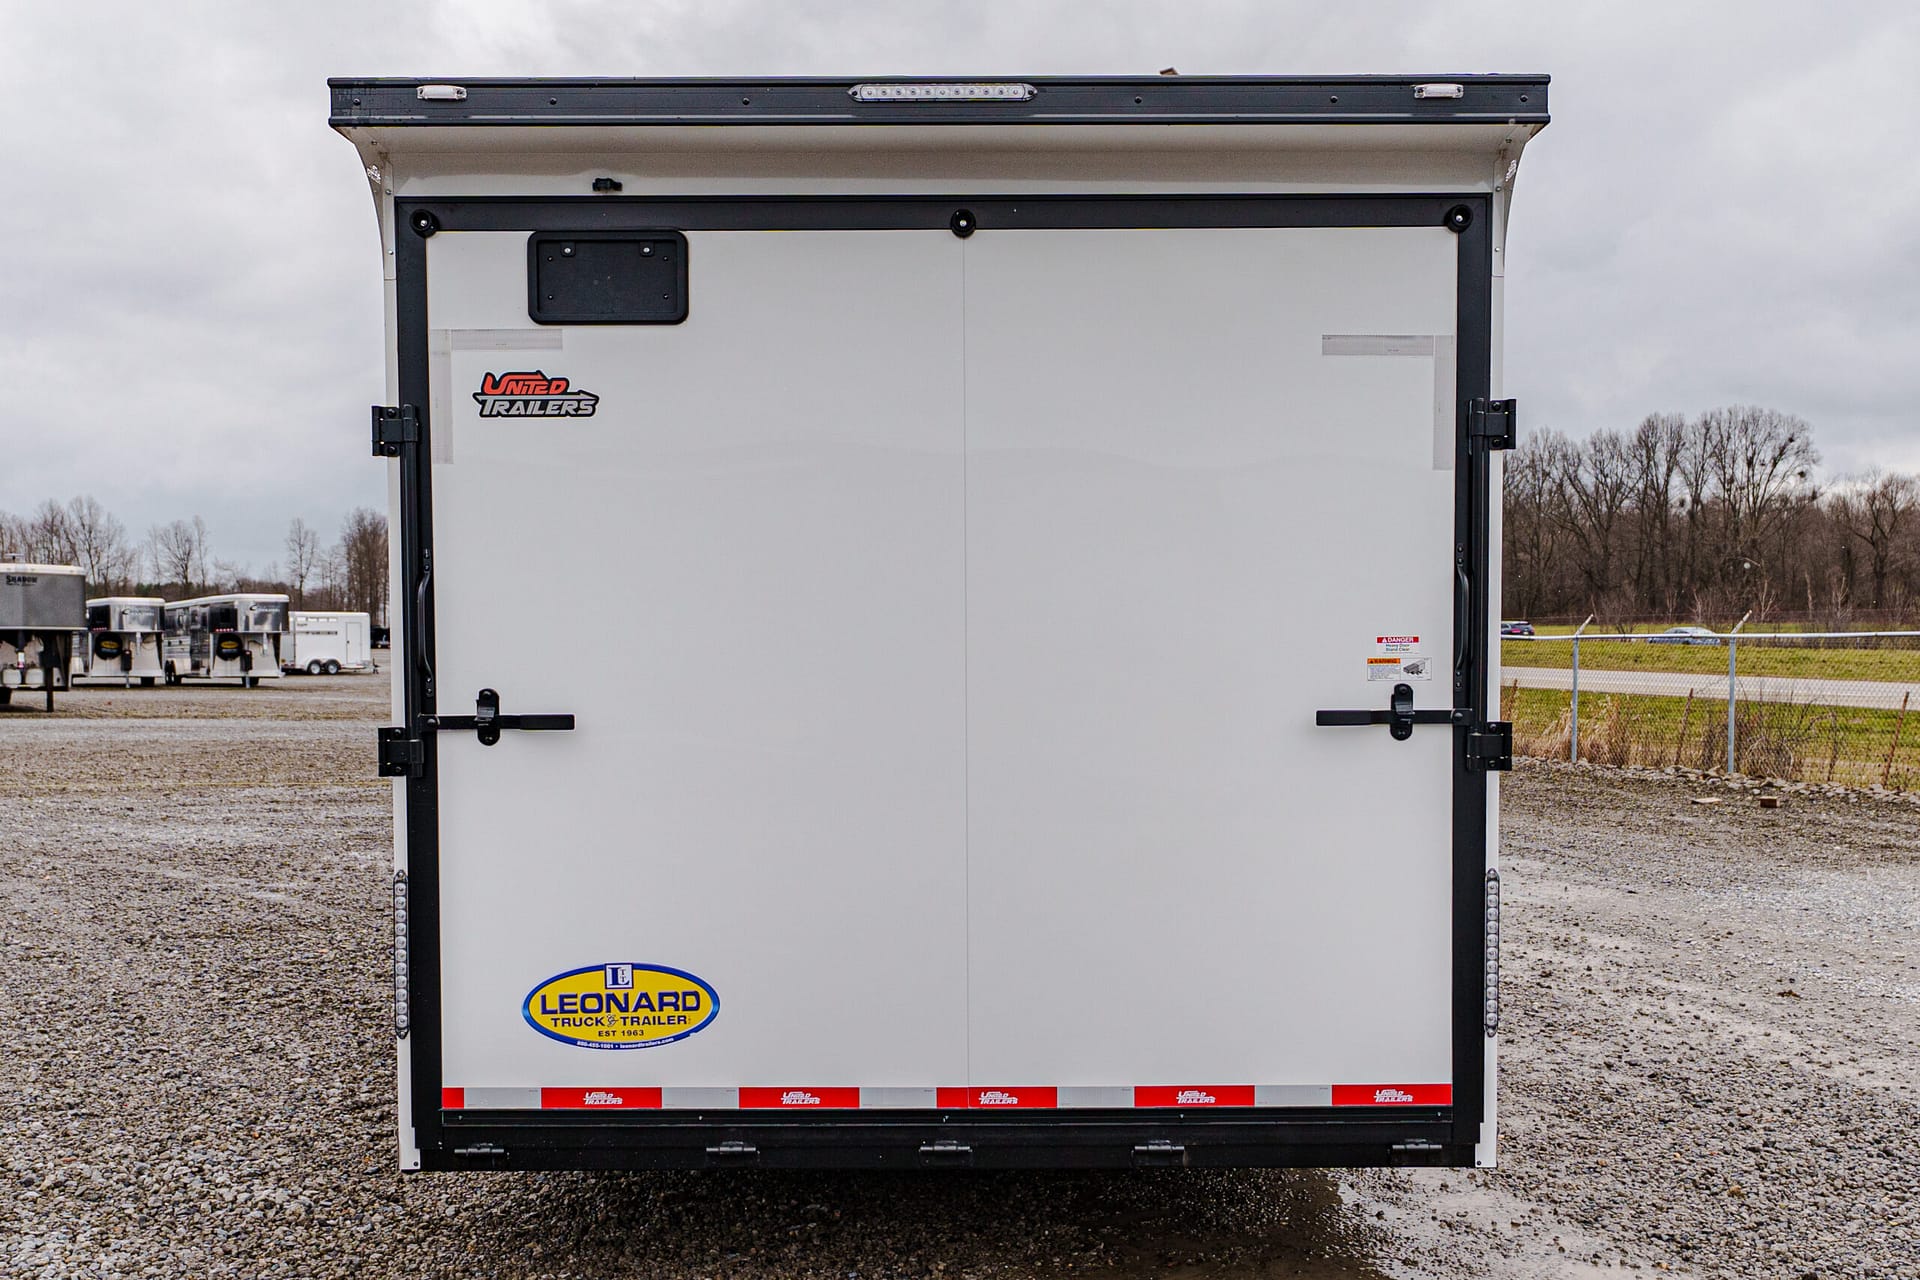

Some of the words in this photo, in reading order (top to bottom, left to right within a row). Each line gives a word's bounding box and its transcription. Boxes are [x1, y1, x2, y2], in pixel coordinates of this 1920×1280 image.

[482, 372, 568, 395] UNITED
[475, 394, 597, 416] TRAILERS
[541, 990, 700, 1014] LEONARD
[550, 1016, 605, 1027] TRUCK
[620, 1015, 687, 1026] TRAILER
[621, 1029, 645, 1037] 1963
